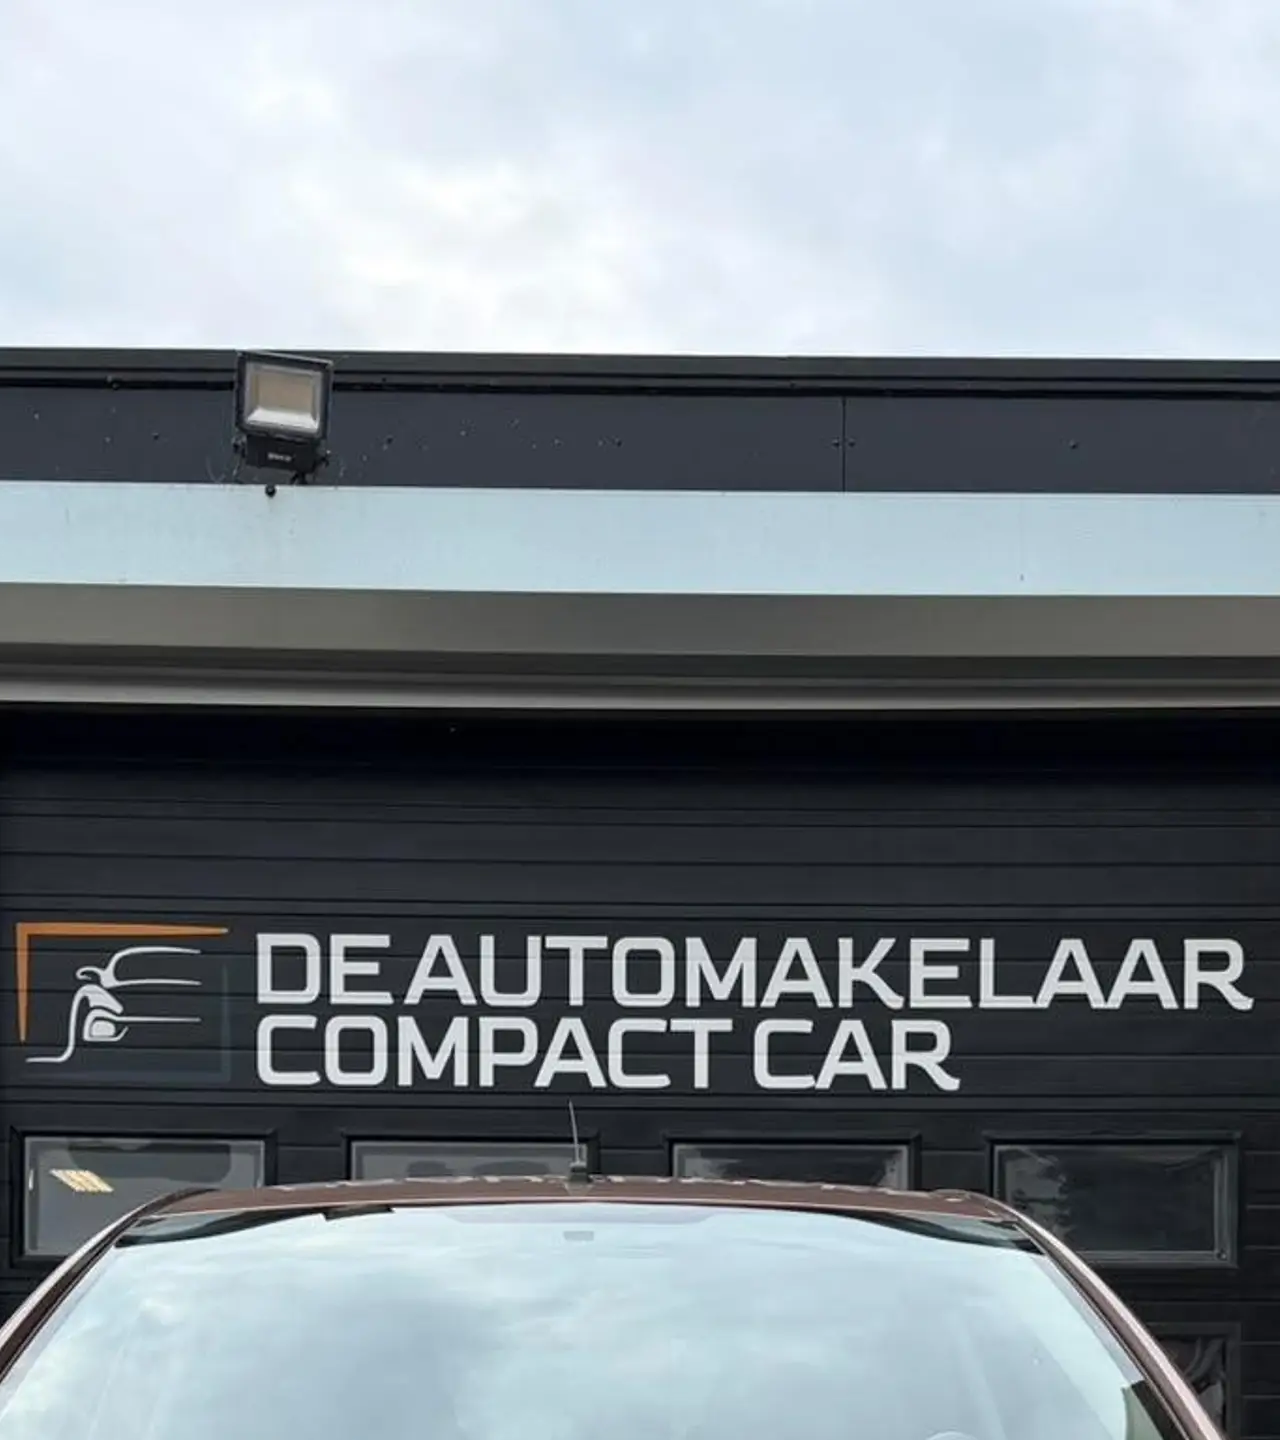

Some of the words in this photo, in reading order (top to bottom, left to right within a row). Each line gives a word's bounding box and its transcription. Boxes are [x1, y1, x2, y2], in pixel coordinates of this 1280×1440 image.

[256, 933, 394, 1005] DE
[403, 934, 1254, 1011] AUTOMAKELAAR
[257, 1014, 733, 1089] COMPACT
[753, 1018, 961, 1091] CAR
